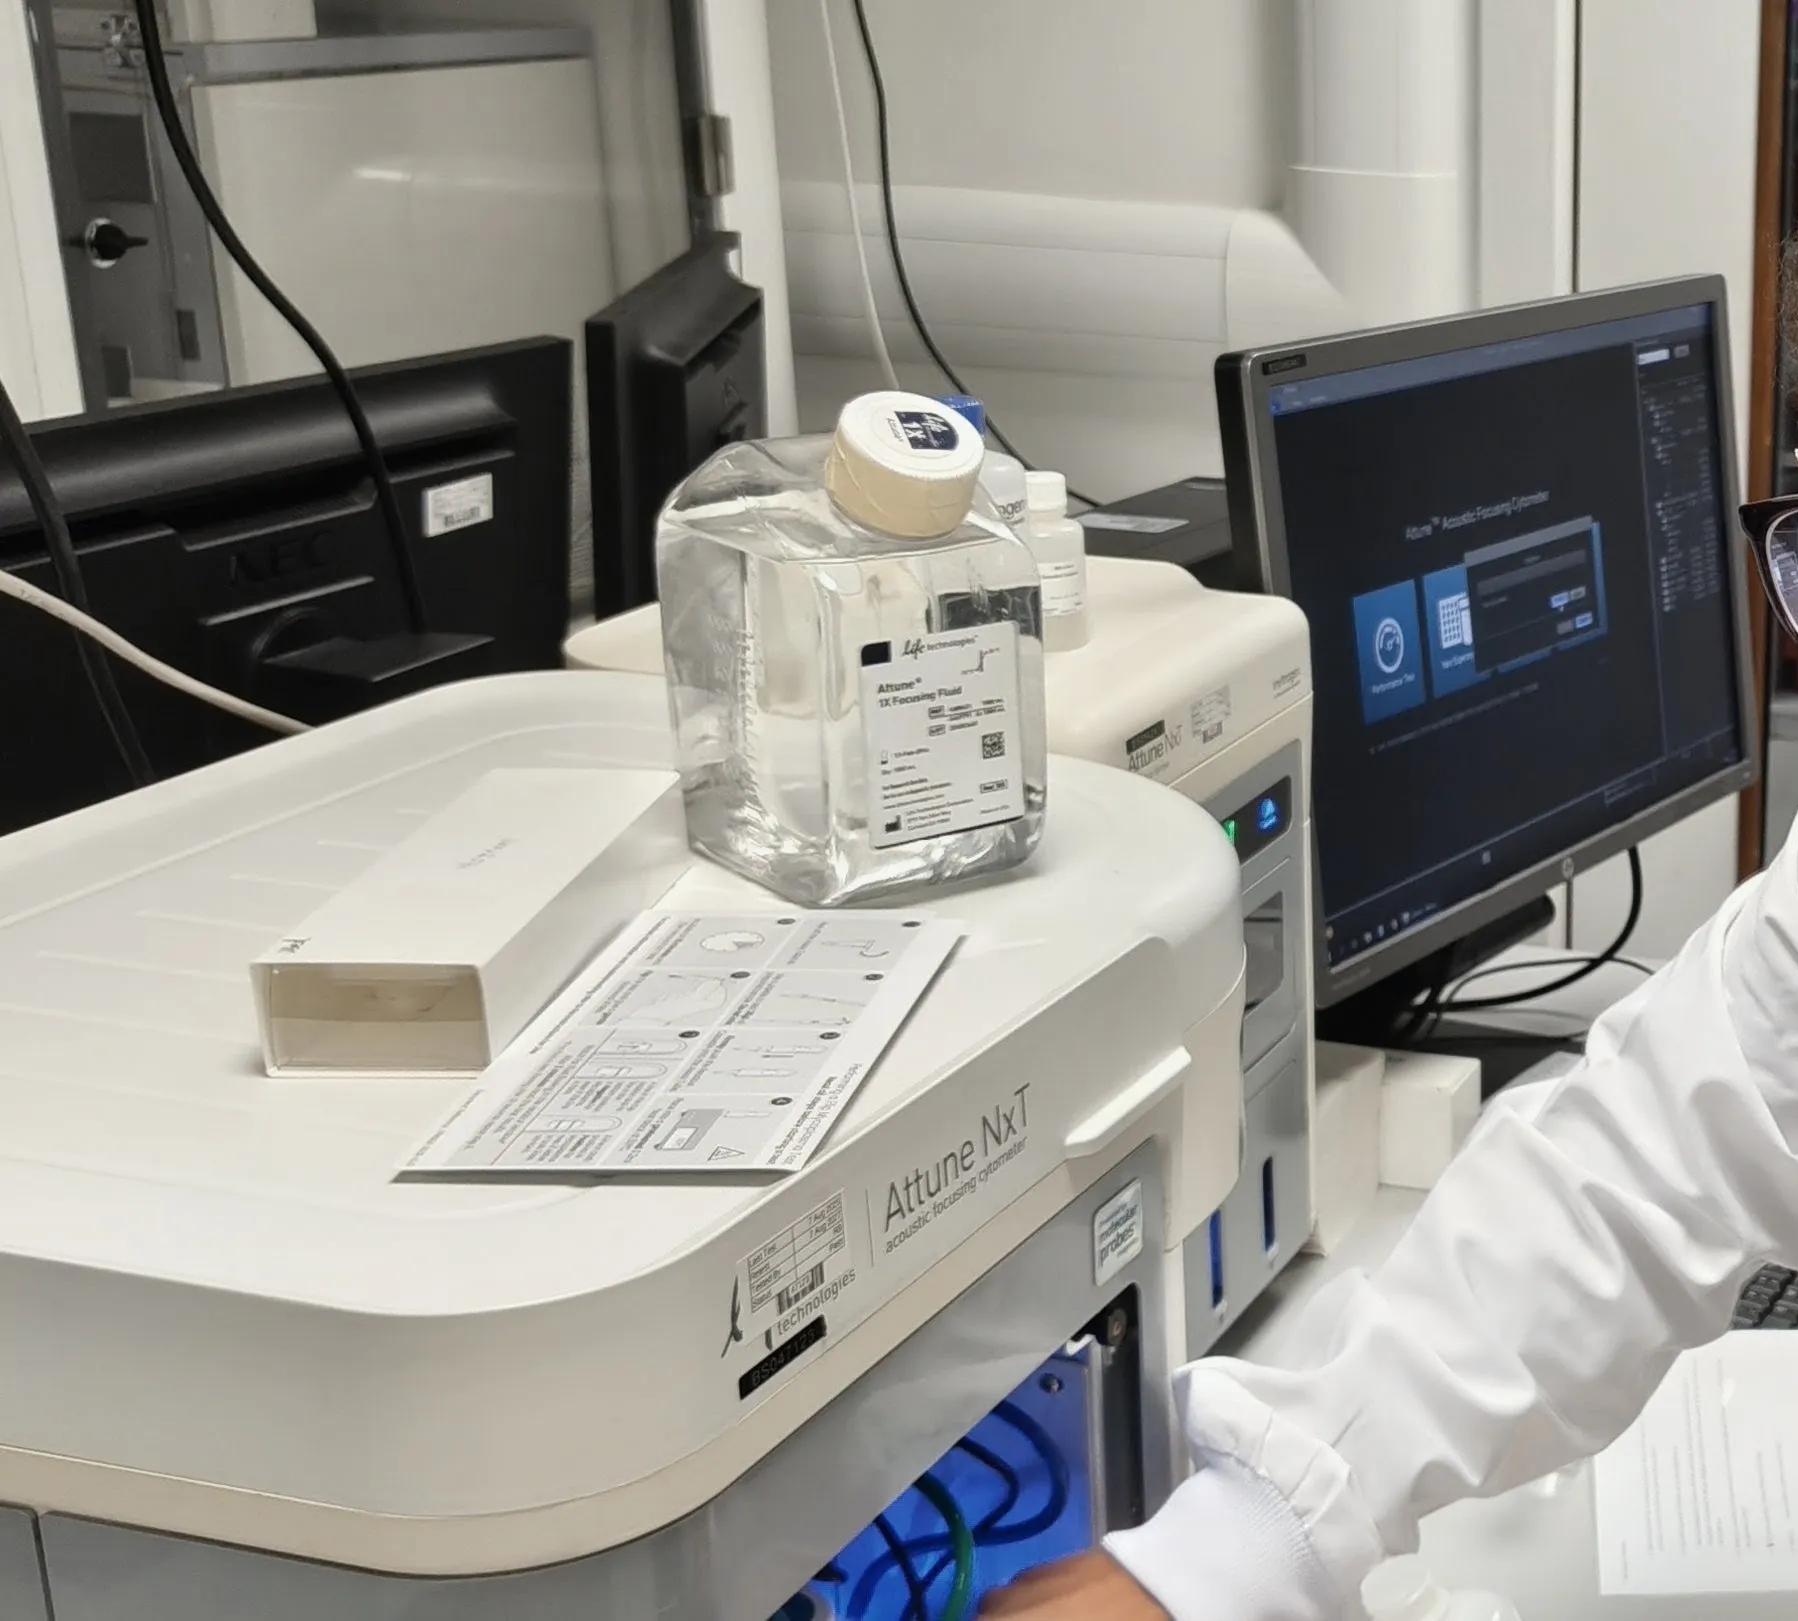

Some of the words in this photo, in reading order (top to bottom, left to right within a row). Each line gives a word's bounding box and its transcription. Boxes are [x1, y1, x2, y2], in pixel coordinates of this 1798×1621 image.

[884, 1140, 976, 1233] Attune
[981, 1082, 1031, 1158] NxT
[885, 1210, 932, 1254] acoustic
[932, 1176, 978, 1218] focusing
[978, 1136, 1028, 1184] cytometer
[777, 1267, 856, 1336] technologies
